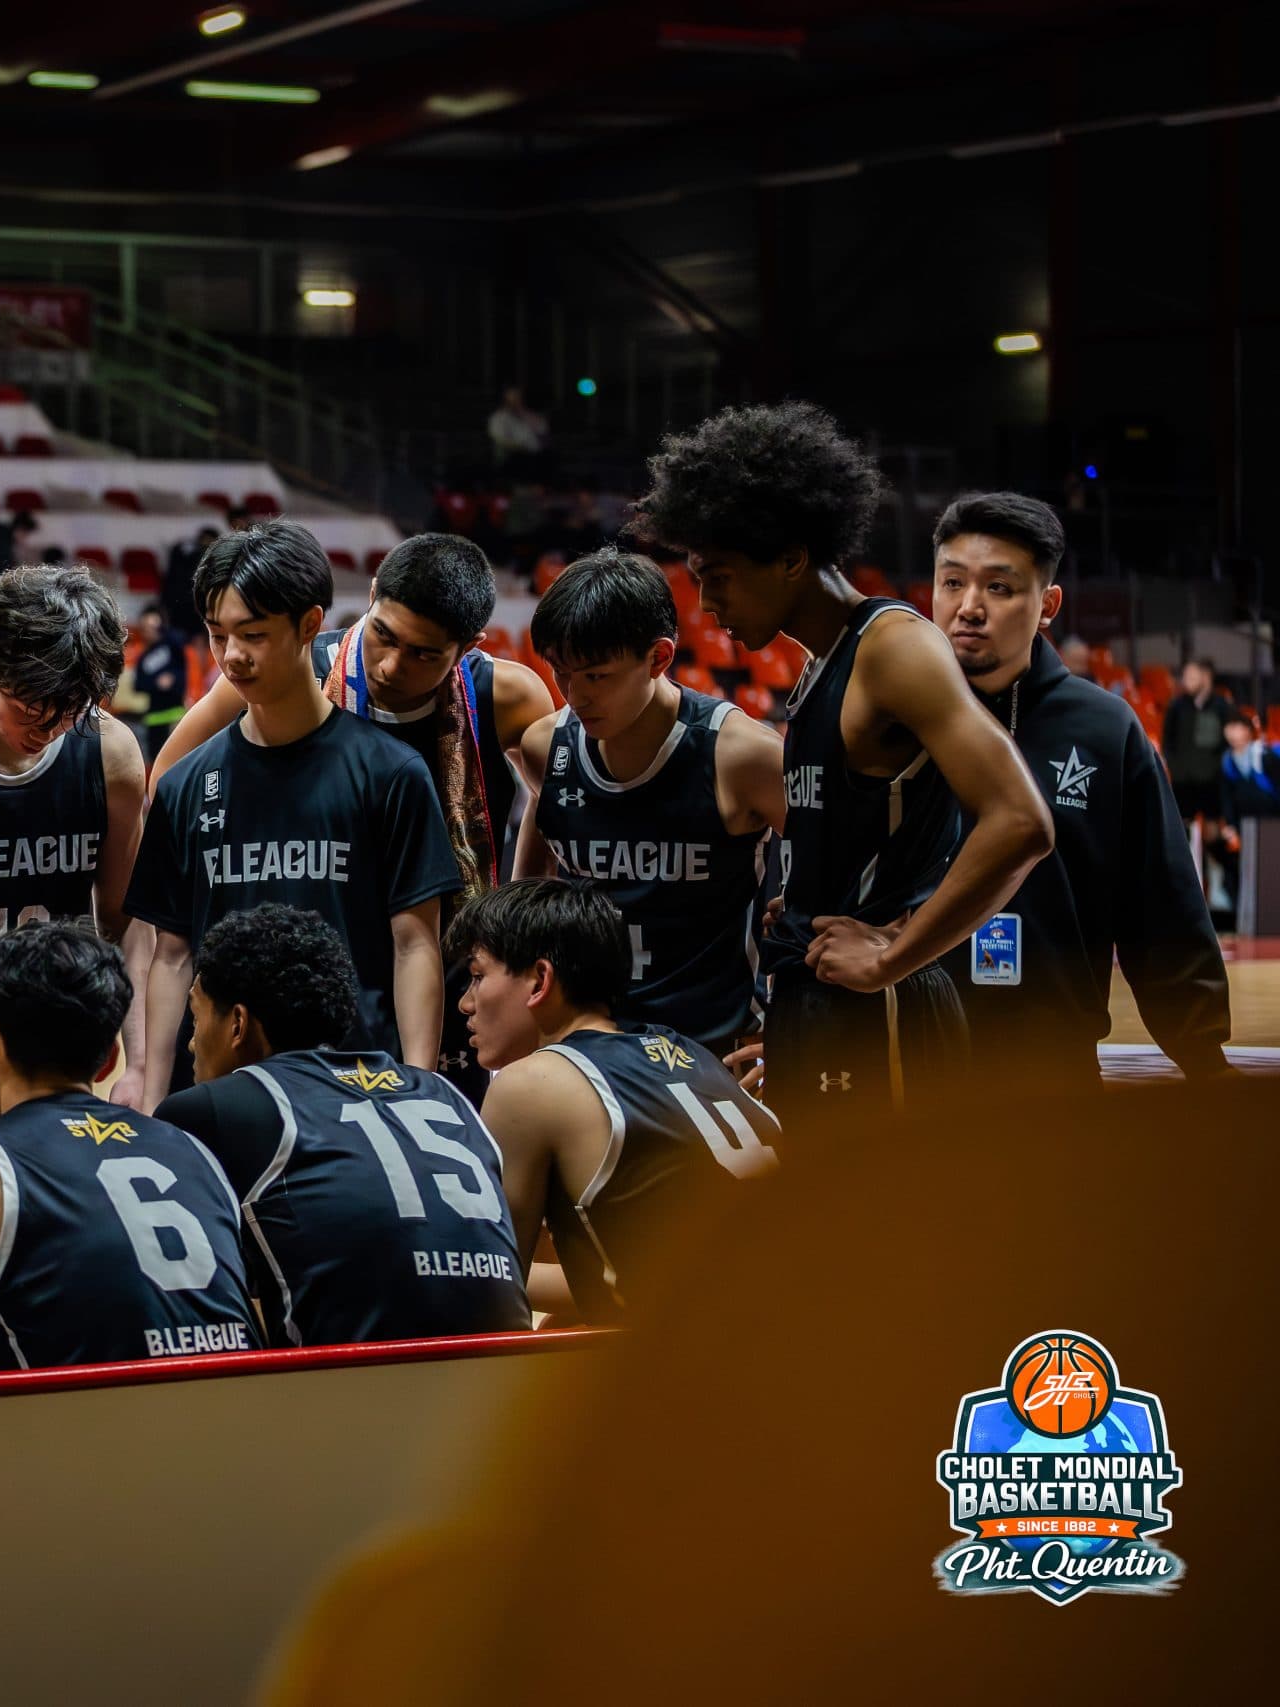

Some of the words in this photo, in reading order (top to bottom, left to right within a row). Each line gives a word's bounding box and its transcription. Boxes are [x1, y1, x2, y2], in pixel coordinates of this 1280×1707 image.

[339, 1099, 504, 1224] 15
[95, 1156, 218, 1292] 6
[413, 1250, 513, 1282] B.LEAGUE
[143, 1322, 249, 1358] B.LEAGUE
